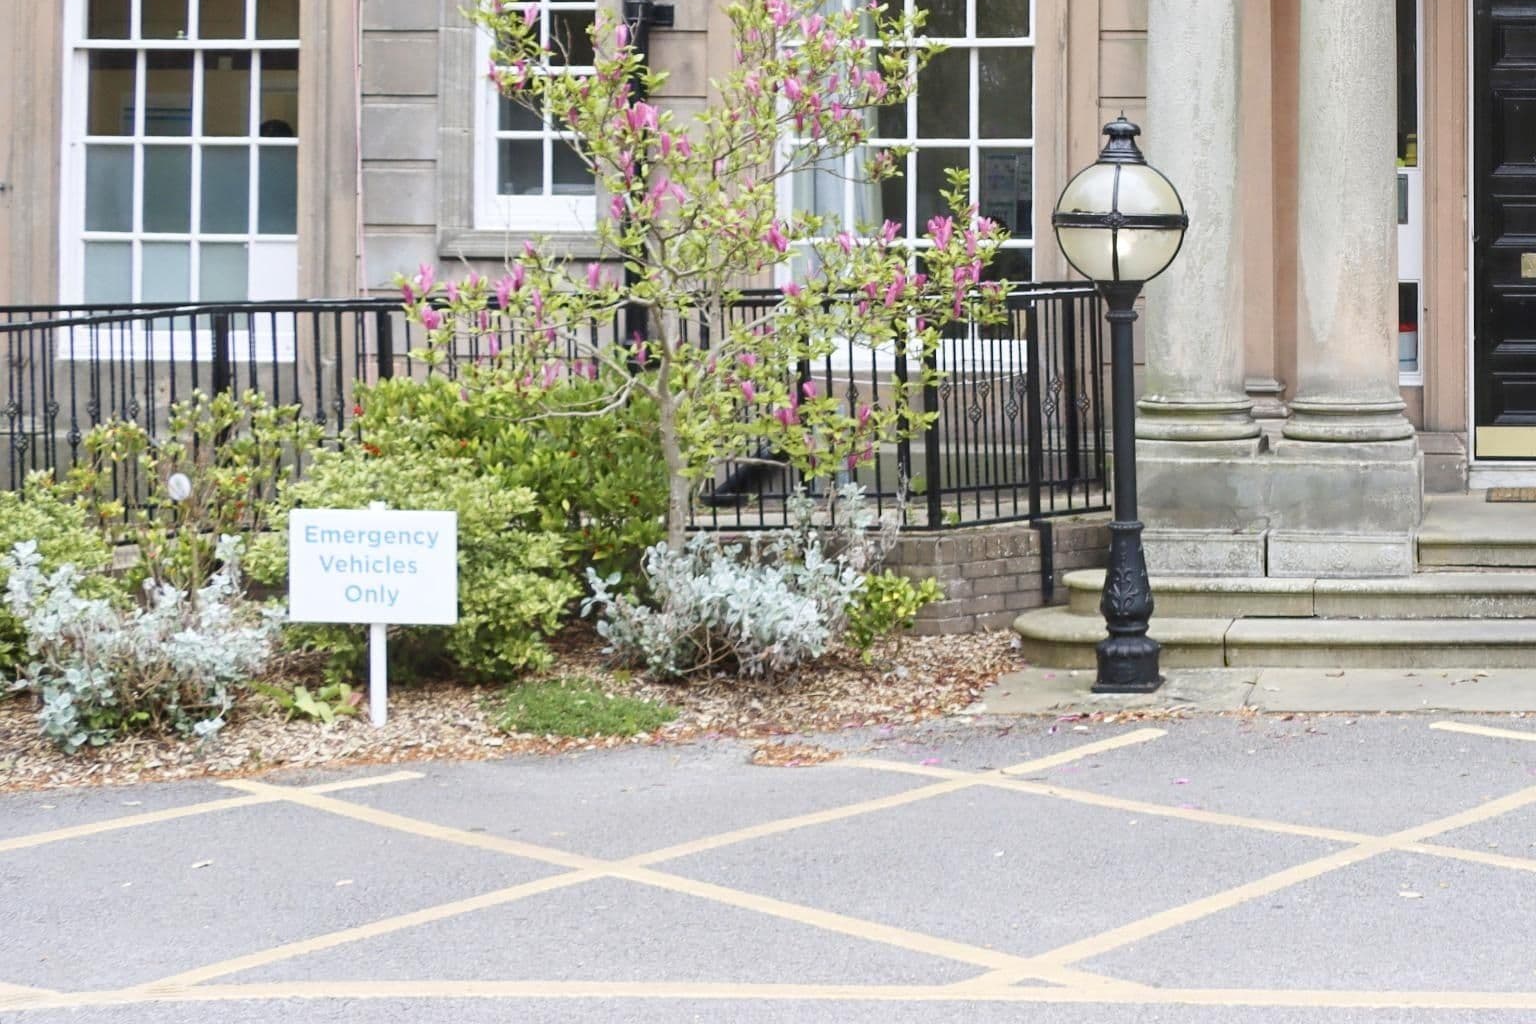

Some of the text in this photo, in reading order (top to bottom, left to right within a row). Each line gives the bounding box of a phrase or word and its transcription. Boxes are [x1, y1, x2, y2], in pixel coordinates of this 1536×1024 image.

[304, 525, 439, 549] Emergency
[319, 555, 418, 574] Vehicles
[344, 584, 399, 606] Only
